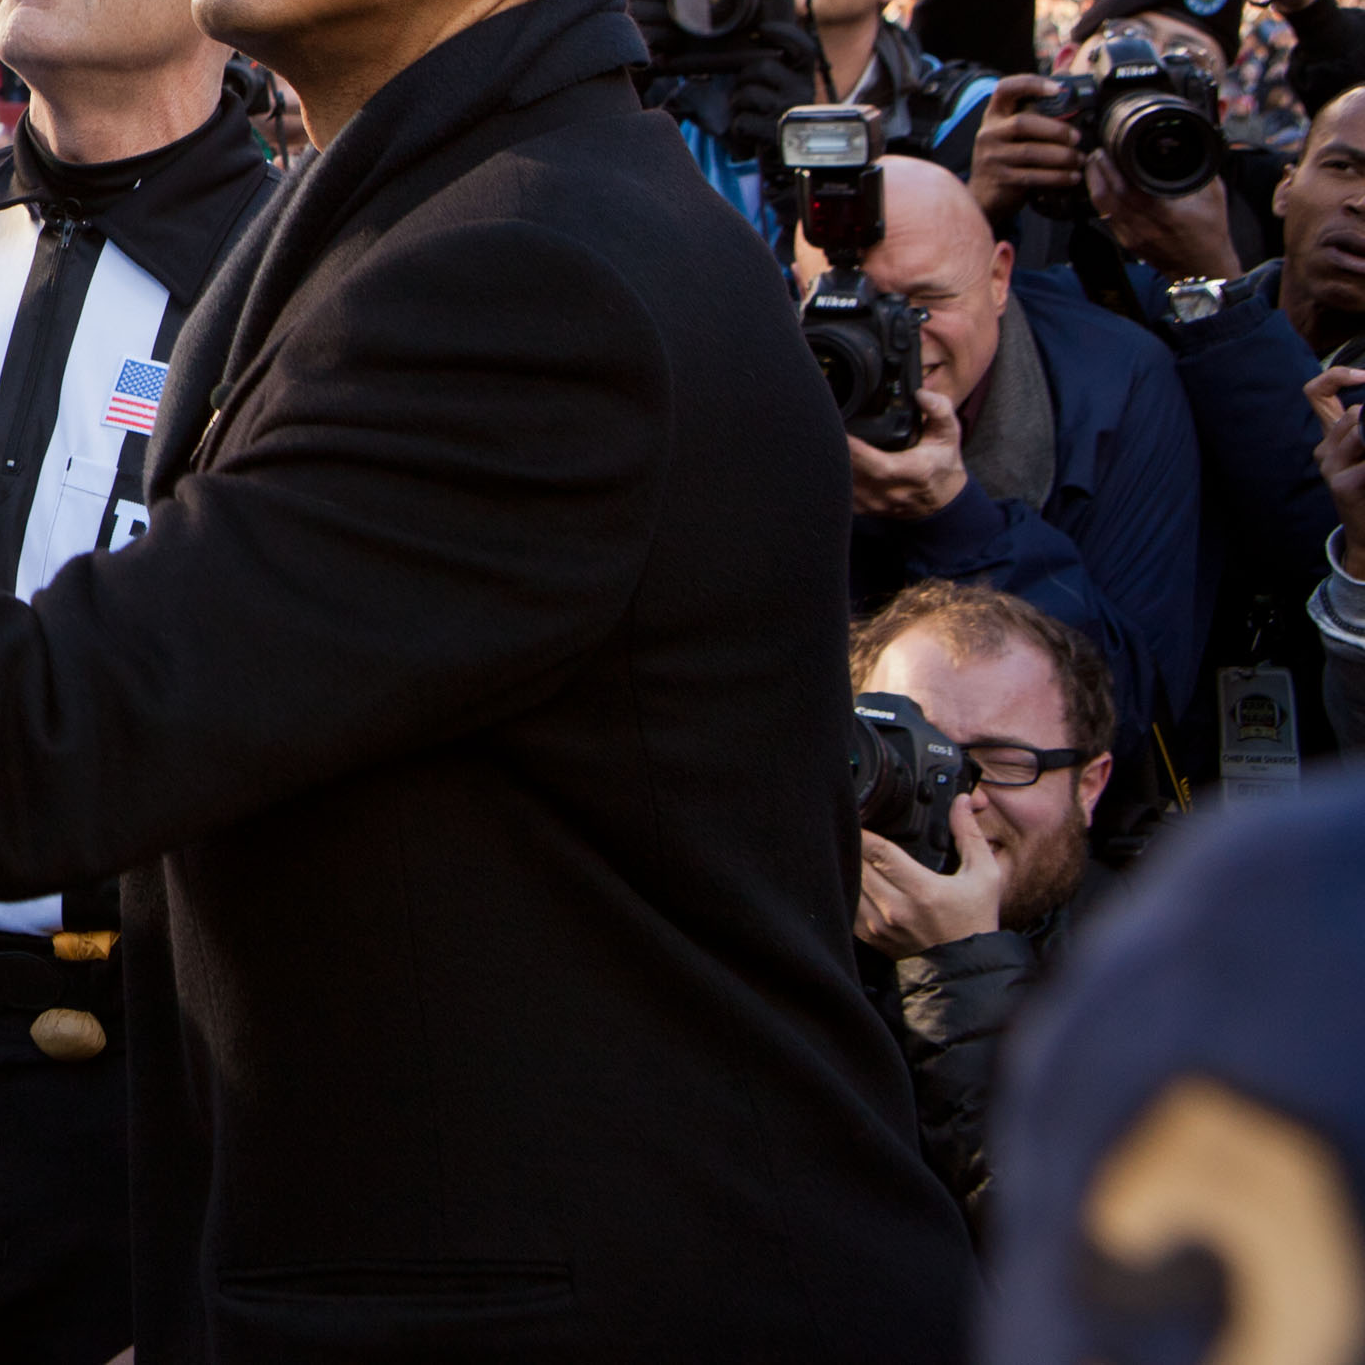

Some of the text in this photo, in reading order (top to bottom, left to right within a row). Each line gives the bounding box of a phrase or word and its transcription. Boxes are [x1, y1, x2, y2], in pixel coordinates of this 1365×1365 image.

[1115, 65, 1158, 79] Nikon
[815, 296, 858, 307] Nikon
[855, 706, 896, 721] Canon
